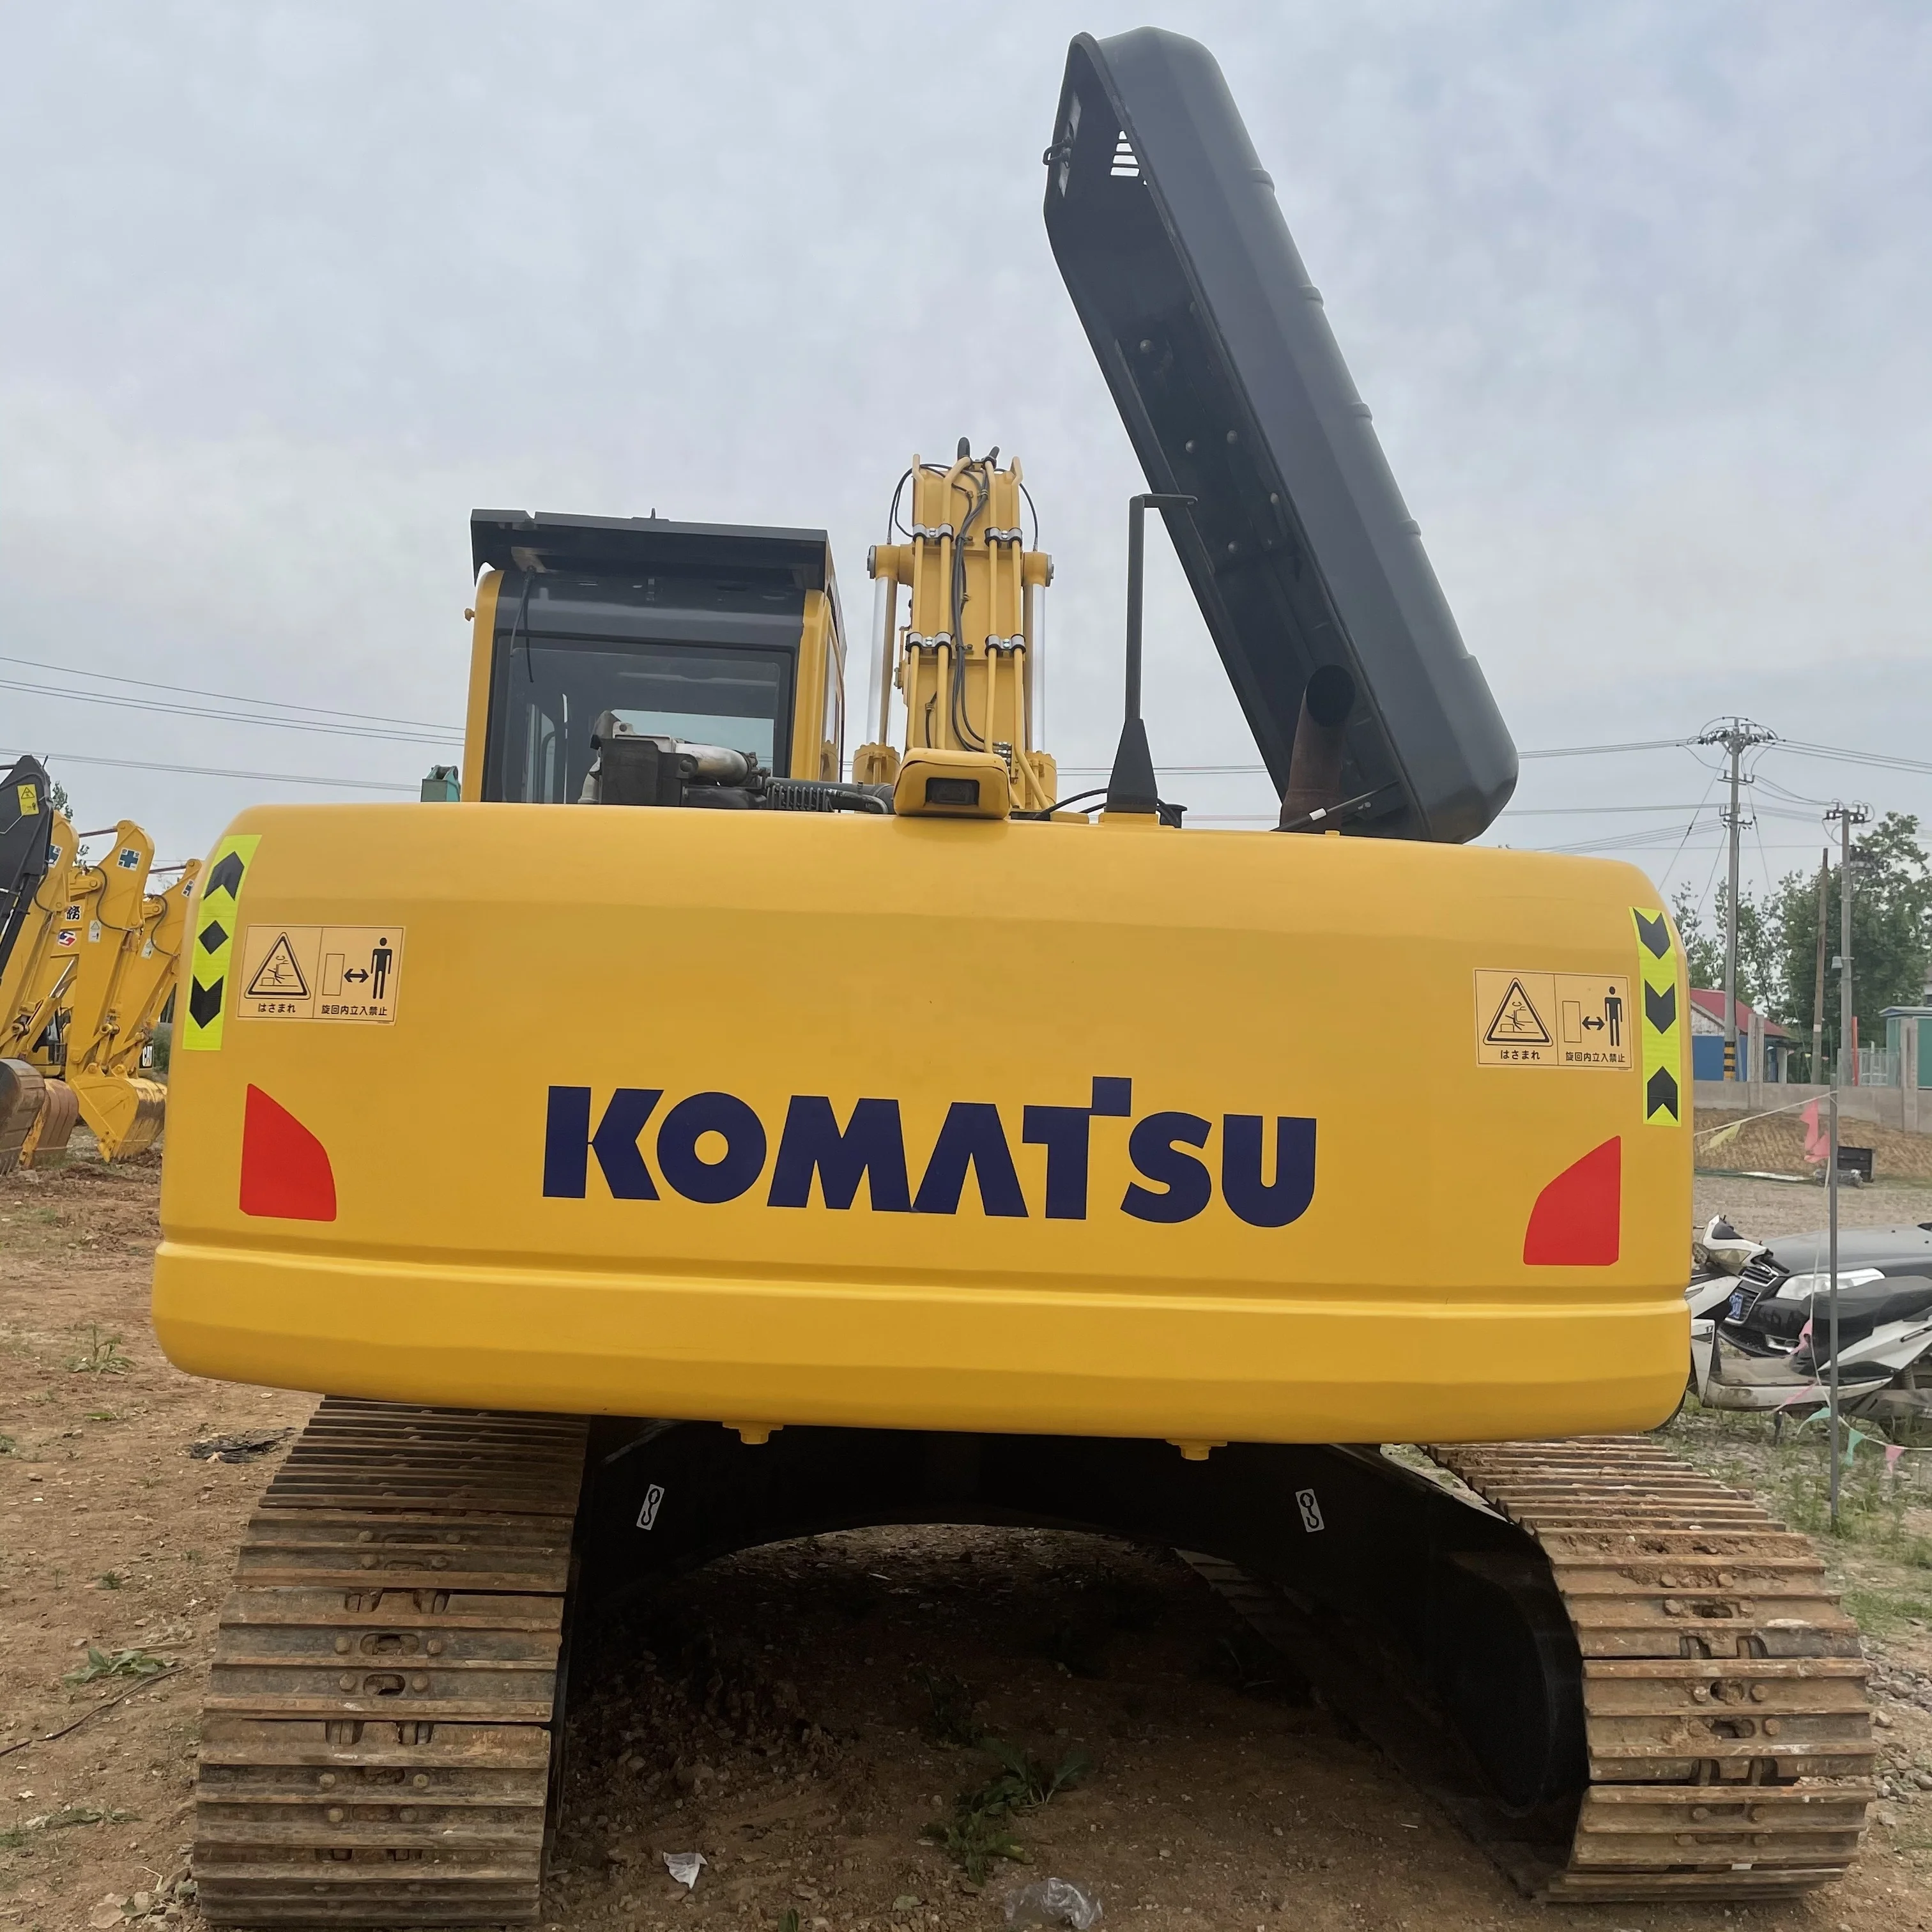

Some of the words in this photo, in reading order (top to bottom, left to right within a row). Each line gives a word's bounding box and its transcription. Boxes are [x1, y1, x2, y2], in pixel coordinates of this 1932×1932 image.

[258, 1003, 296, 1013] はさまれ
[321, 1004, 388, 1016] 旋回内立入禁止
[1501, 1050, 1540, 1060] はさまれ
[1565, 1052, 1626, 1062] 旋回内立入禁止
[542, 1077, 1317, 1228] KOMATSU
